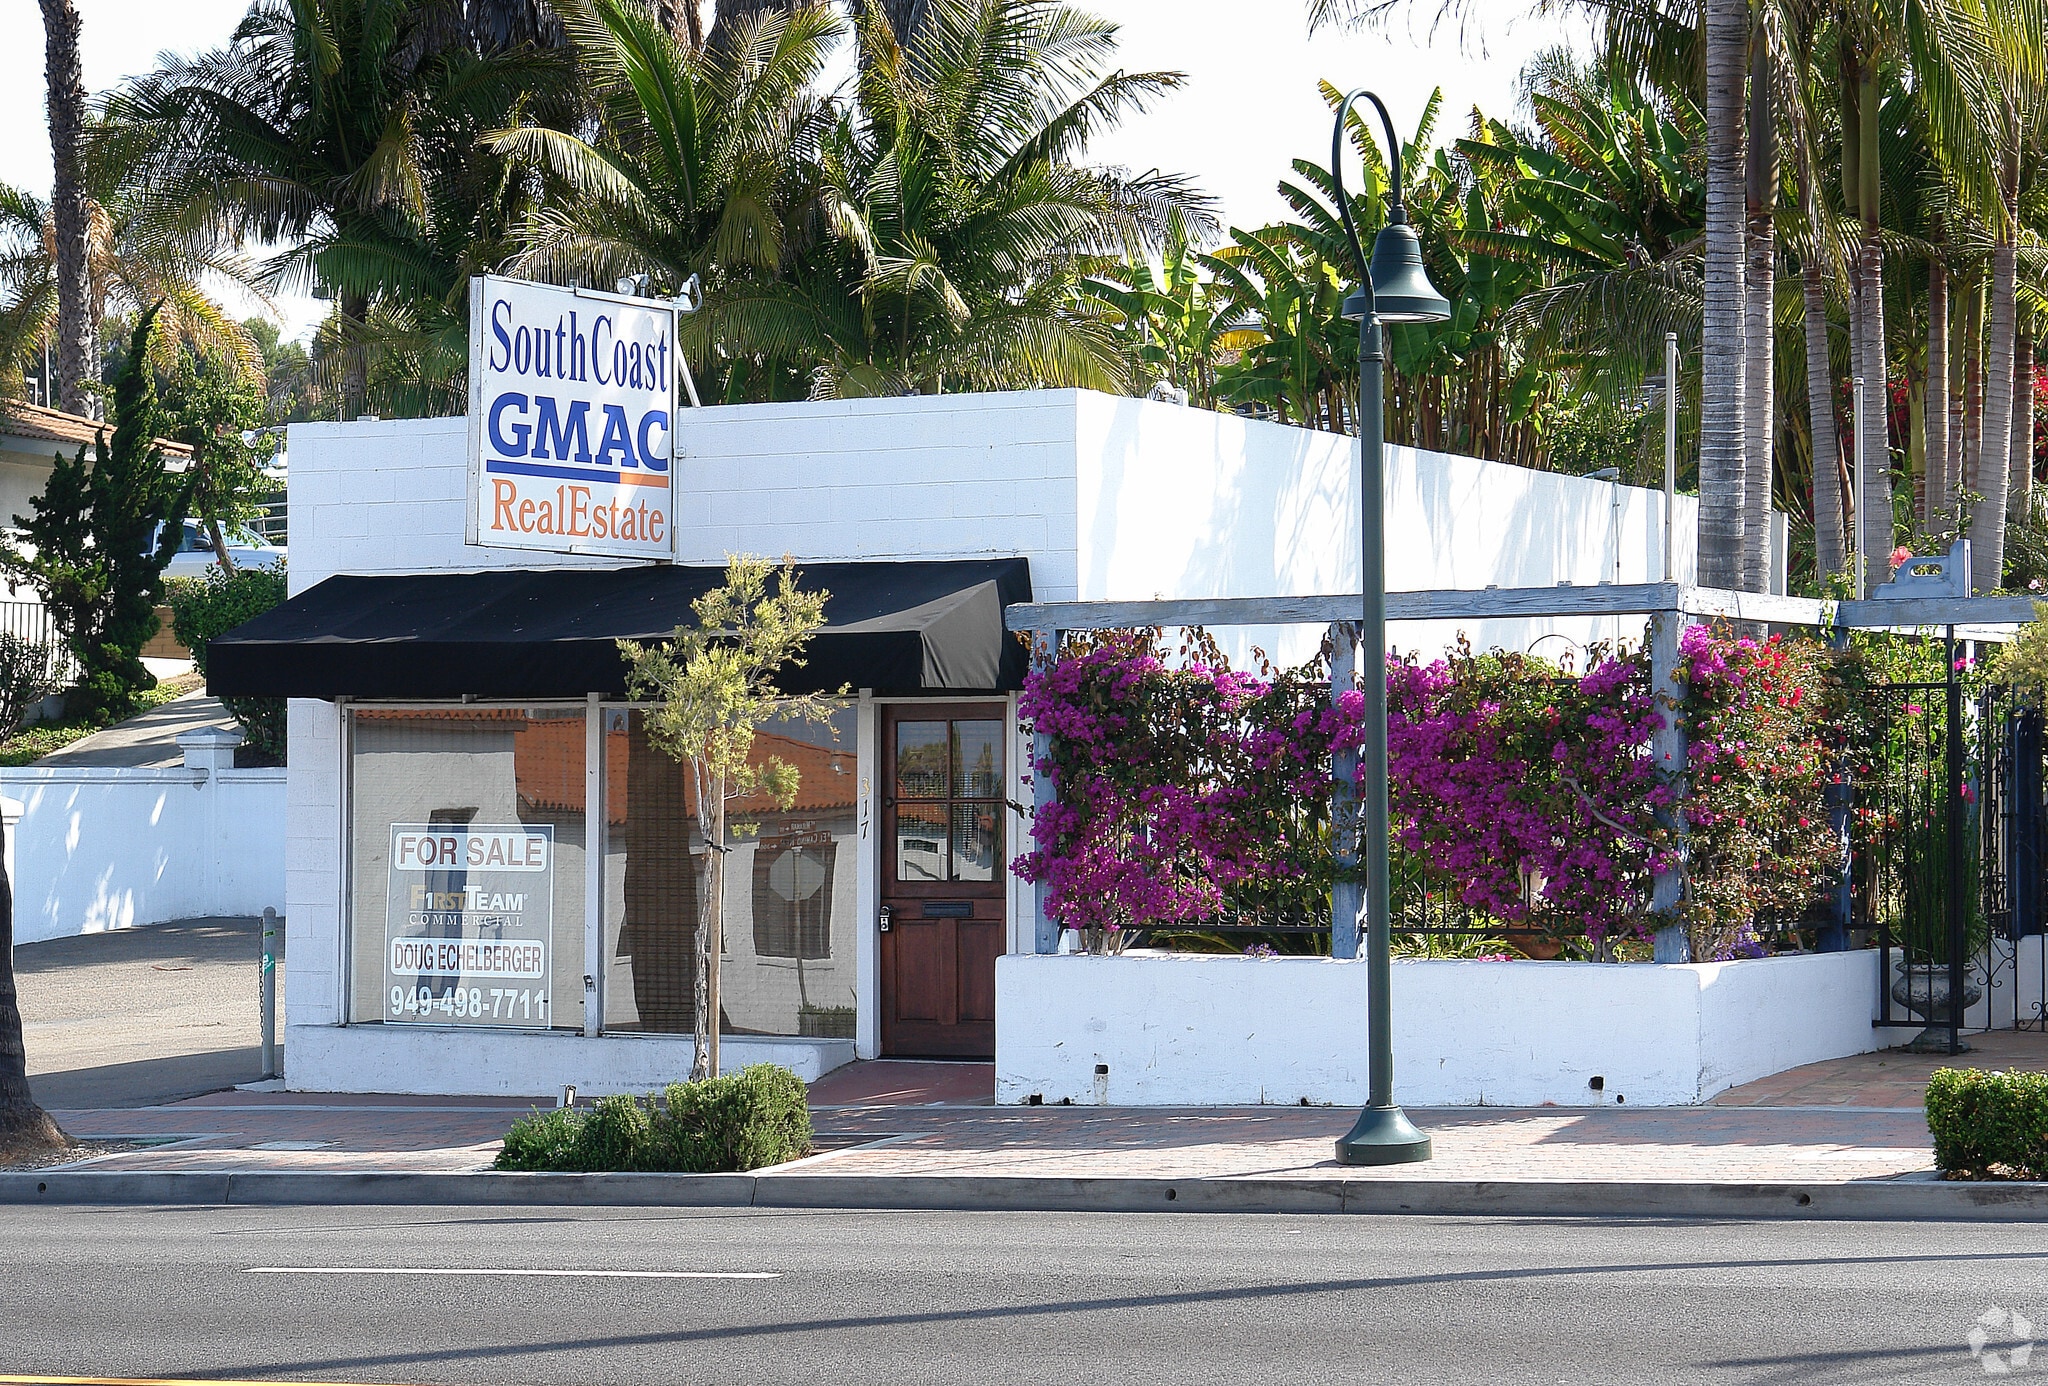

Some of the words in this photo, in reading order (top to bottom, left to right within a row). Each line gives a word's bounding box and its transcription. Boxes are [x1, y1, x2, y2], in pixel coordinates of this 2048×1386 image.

[488, 392, 669, 472] GMAC
[860, 776, 870, 840] 317
[399, 836, 458, 866] FOR
[466, 837, 543, 867] SALE
[409, 913, 523, 927] COMMERCIAL
[394, 943, 434, 971] DOUG
[437, 944, 542, 973] ECHELBERGER
[390, 985, 545, 1020] 949-498-7711
